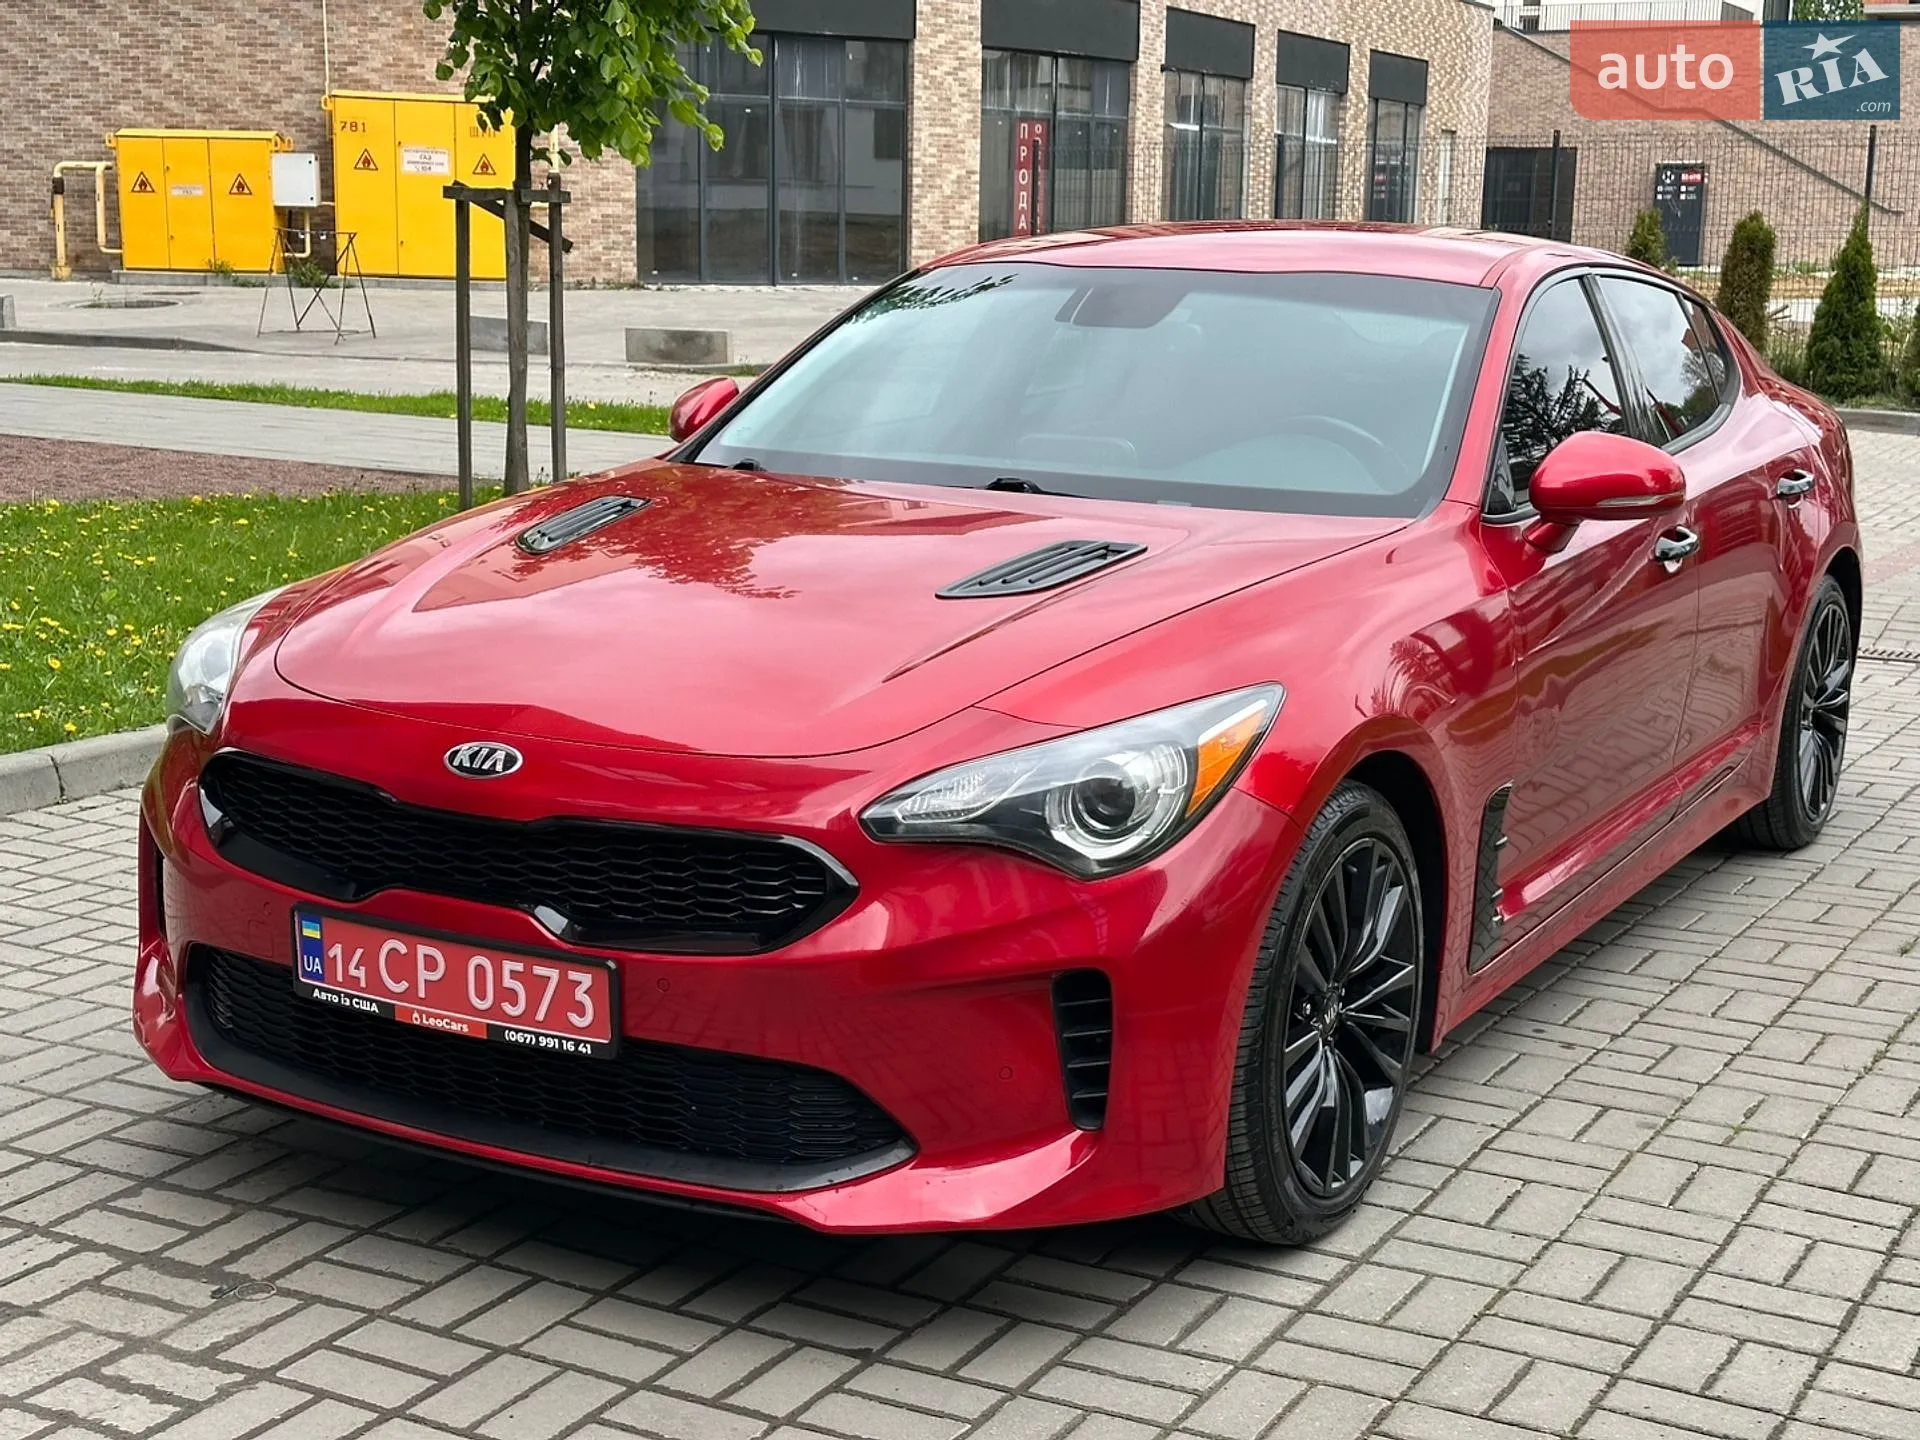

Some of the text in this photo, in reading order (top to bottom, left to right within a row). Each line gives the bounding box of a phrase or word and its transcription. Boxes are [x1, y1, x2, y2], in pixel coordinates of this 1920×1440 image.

[340, 120, 367, 133] 781
[453, 746, 506, 772] KIA
[304, 955, 323, 975] UA
[327, 943, 367, 989] 14
[467, 955, 595, 1029] 0573
[313, 988, 339, 1003] Авто
[352, 998, 379, 1013] США
[422, 1013, 469, 1033] LeoCars
[504, 1030, 592, 1055] (067) 991 16 41
